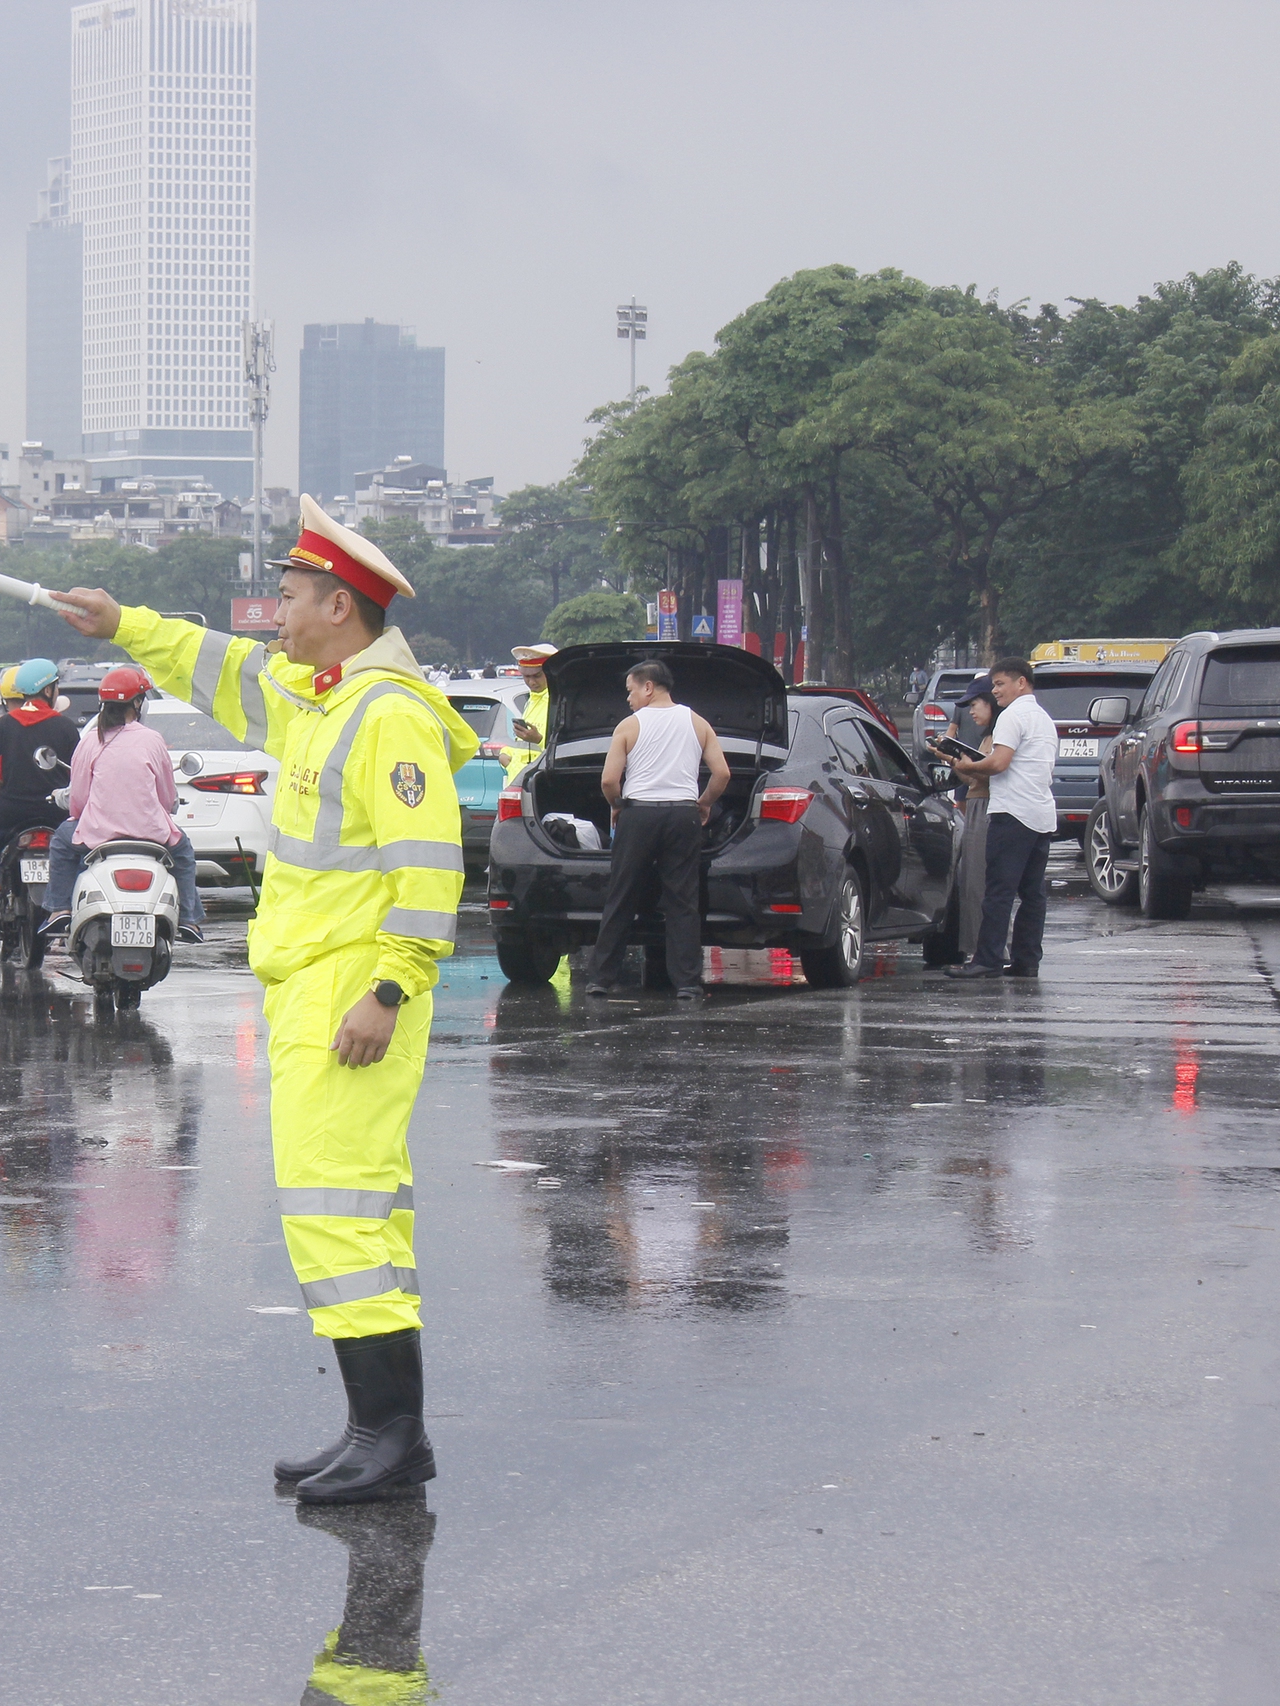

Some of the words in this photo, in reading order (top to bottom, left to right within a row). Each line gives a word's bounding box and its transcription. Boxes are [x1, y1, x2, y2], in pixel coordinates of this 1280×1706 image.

[246, 607, 263, 619] 5G
[1071, 739, 1088, 748] 14A
[1063, 747, 1095, 757] 774.45
[27, 860, 50, 871] 18-K
[23, 870, 50, 882] 578.3
[120, 917, 148, 931] 18-K1
[114, 931, 152, 945] 057.26
